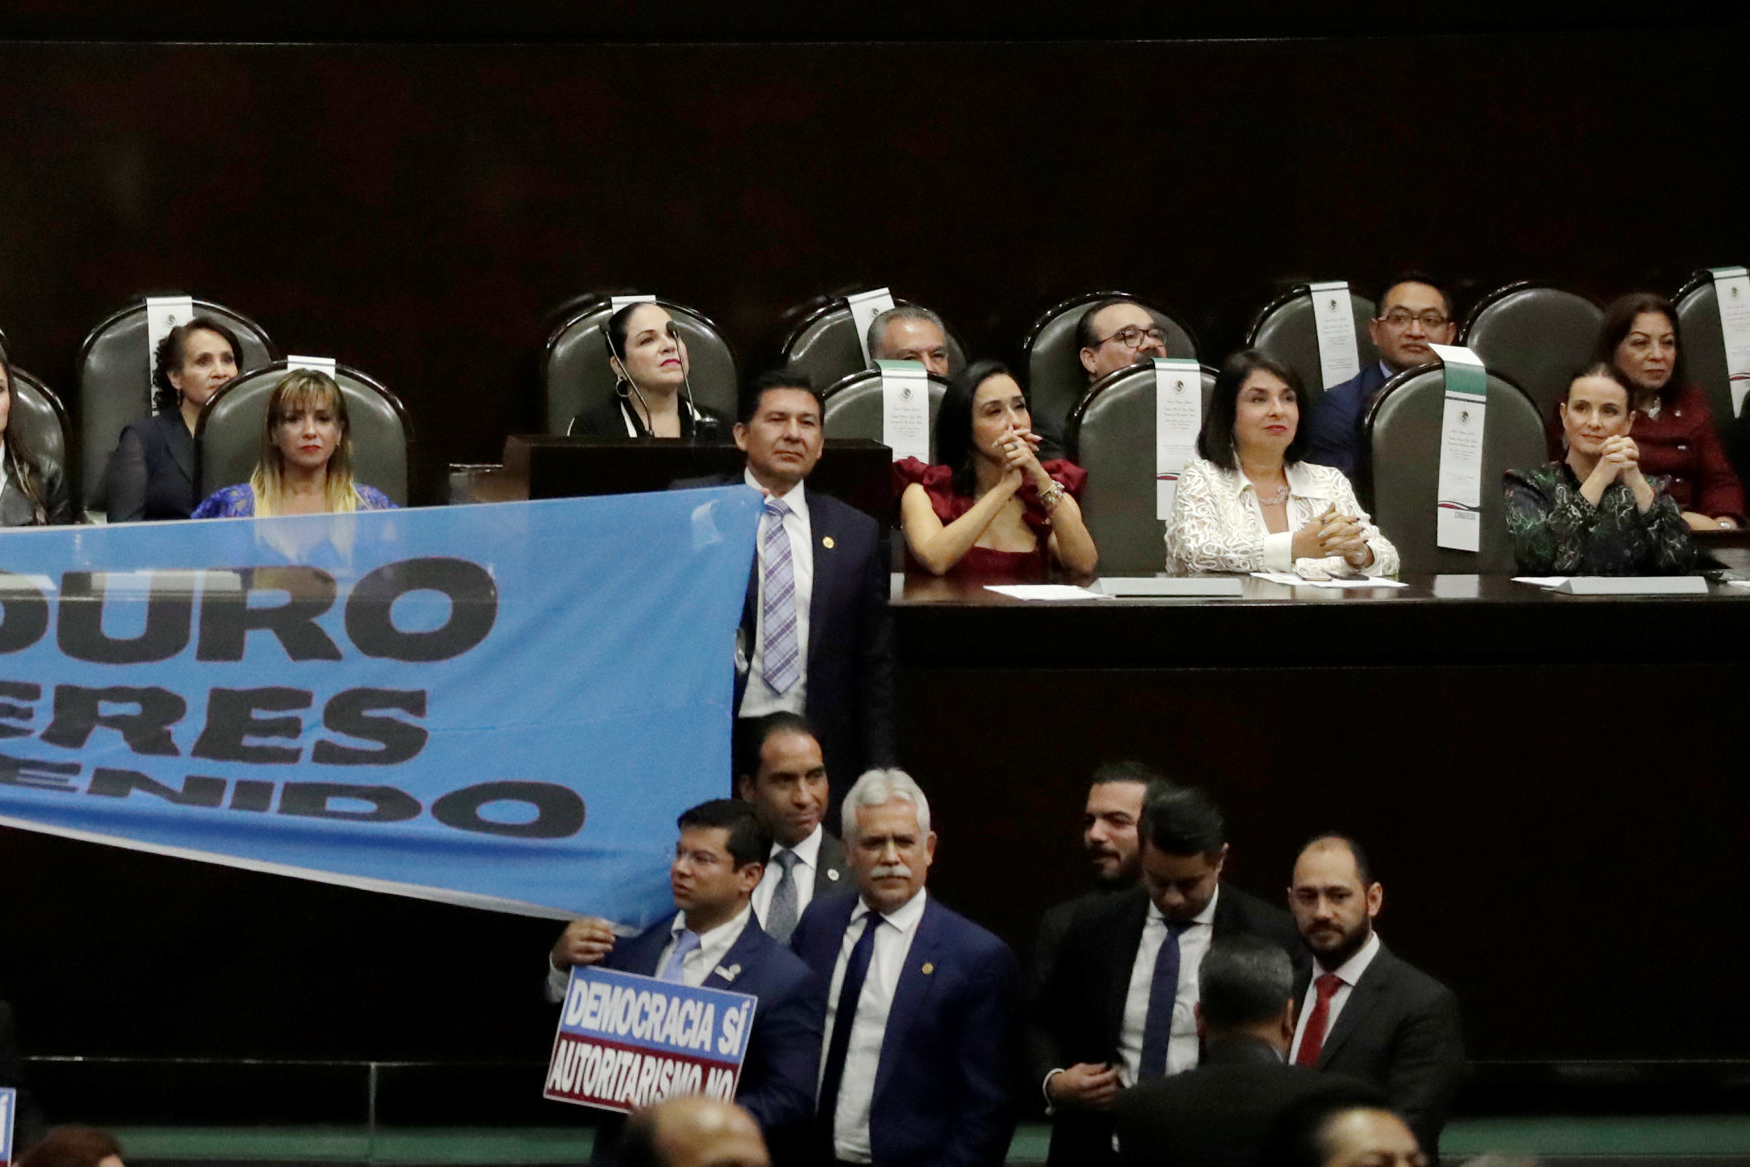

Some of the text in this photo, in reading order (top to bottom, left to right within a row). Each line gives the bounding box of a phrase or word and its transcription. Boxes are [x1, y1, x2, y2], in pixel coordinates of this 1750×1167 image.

[565, 978, 750, 1057] DEMOCRACIA SÍ
[548, 1039, 702, 1107] AUTORITARISMO
